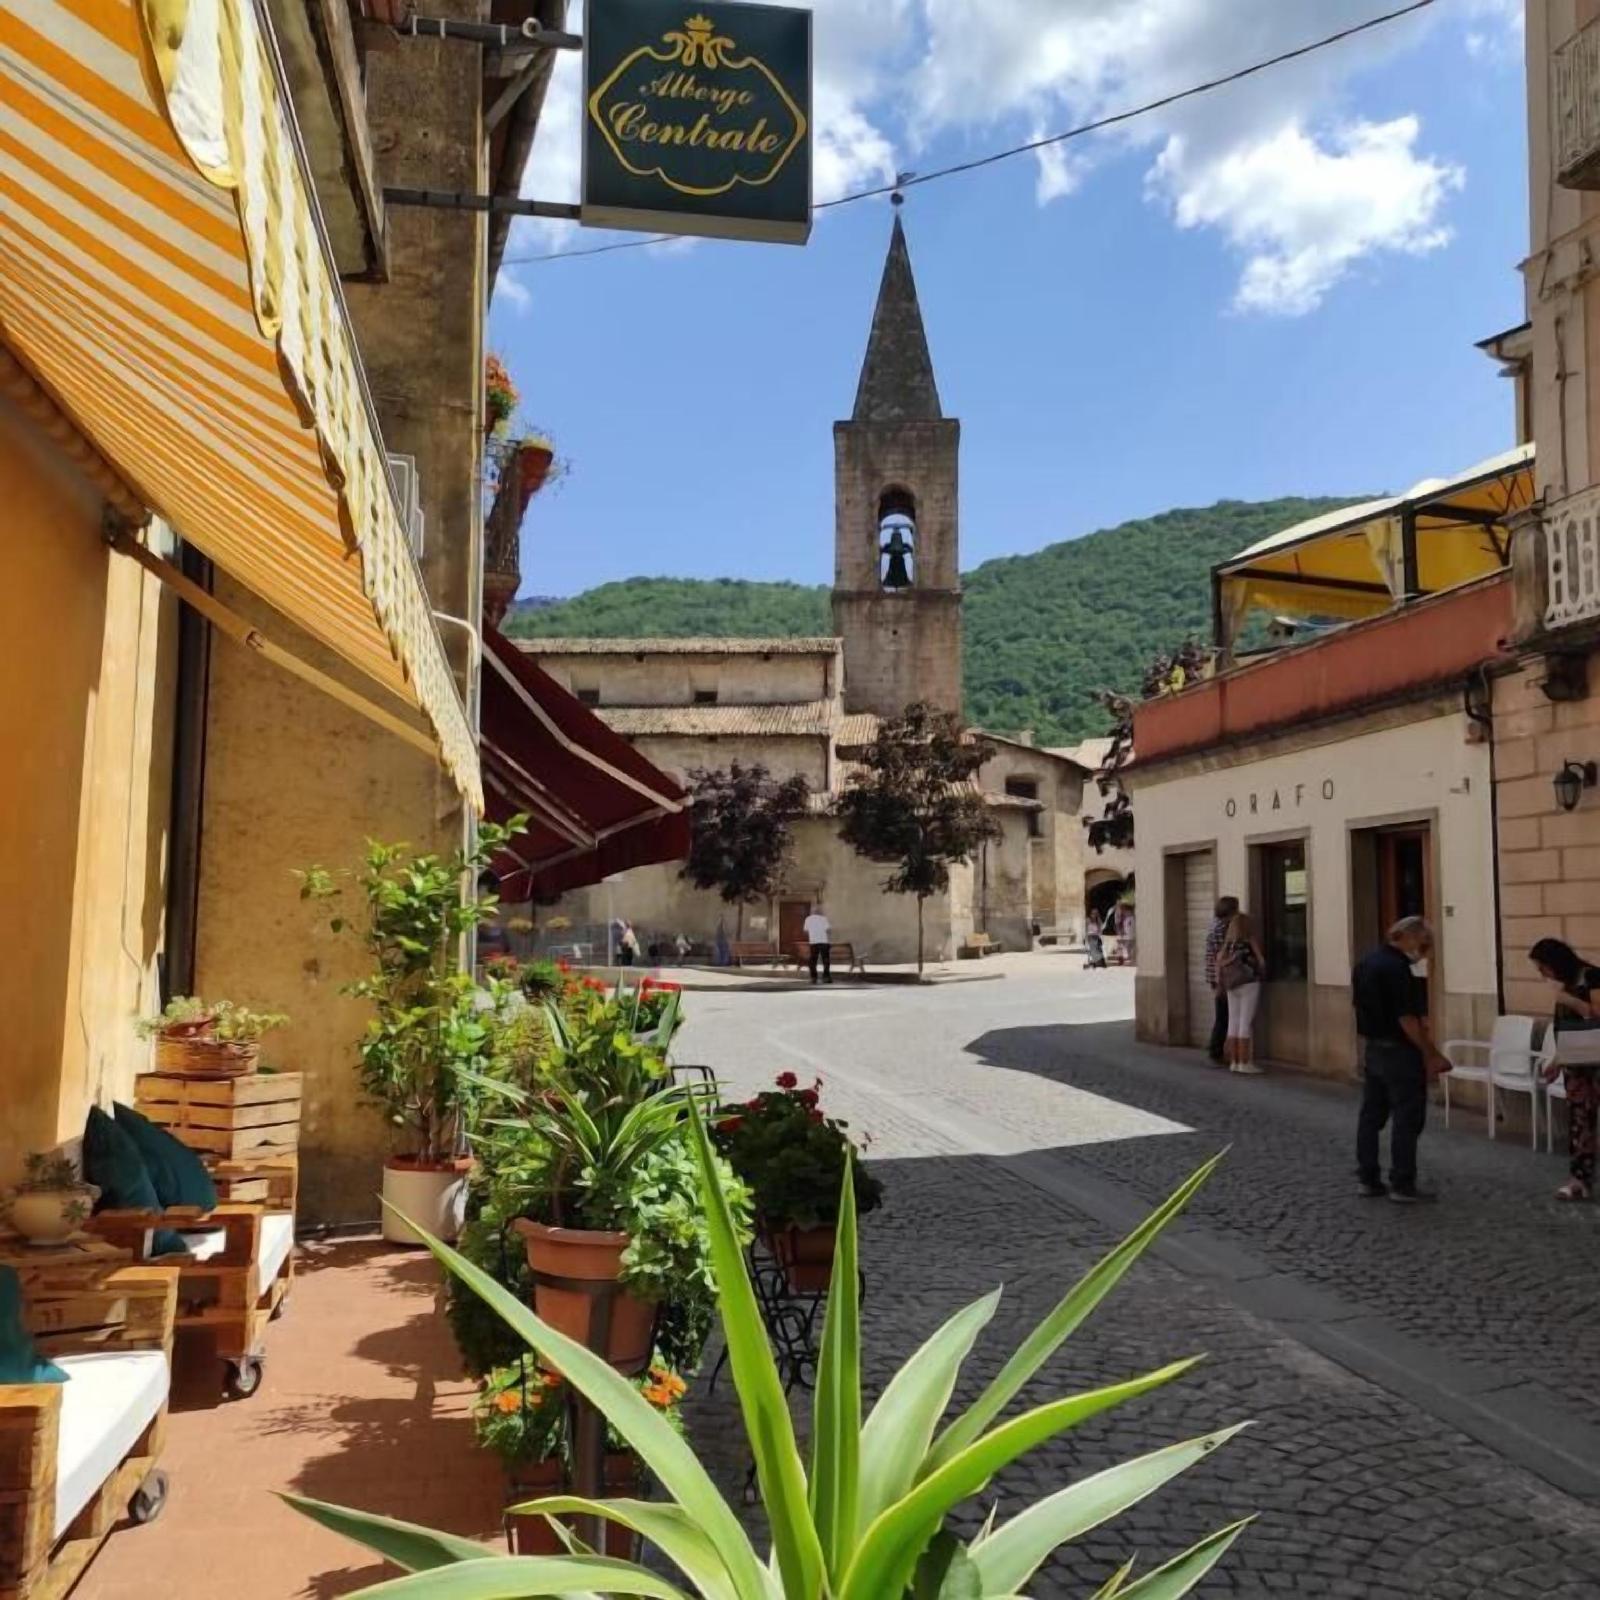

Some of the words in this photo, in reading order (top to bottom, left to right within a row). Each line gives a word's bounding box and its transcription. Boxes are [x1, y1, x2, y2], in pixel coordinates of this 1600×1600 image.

[639, 72, 752, 114] Albergo
[608, 102, 780, 153] Centrale
[1225, 779, 1334, 818] ORAFO
